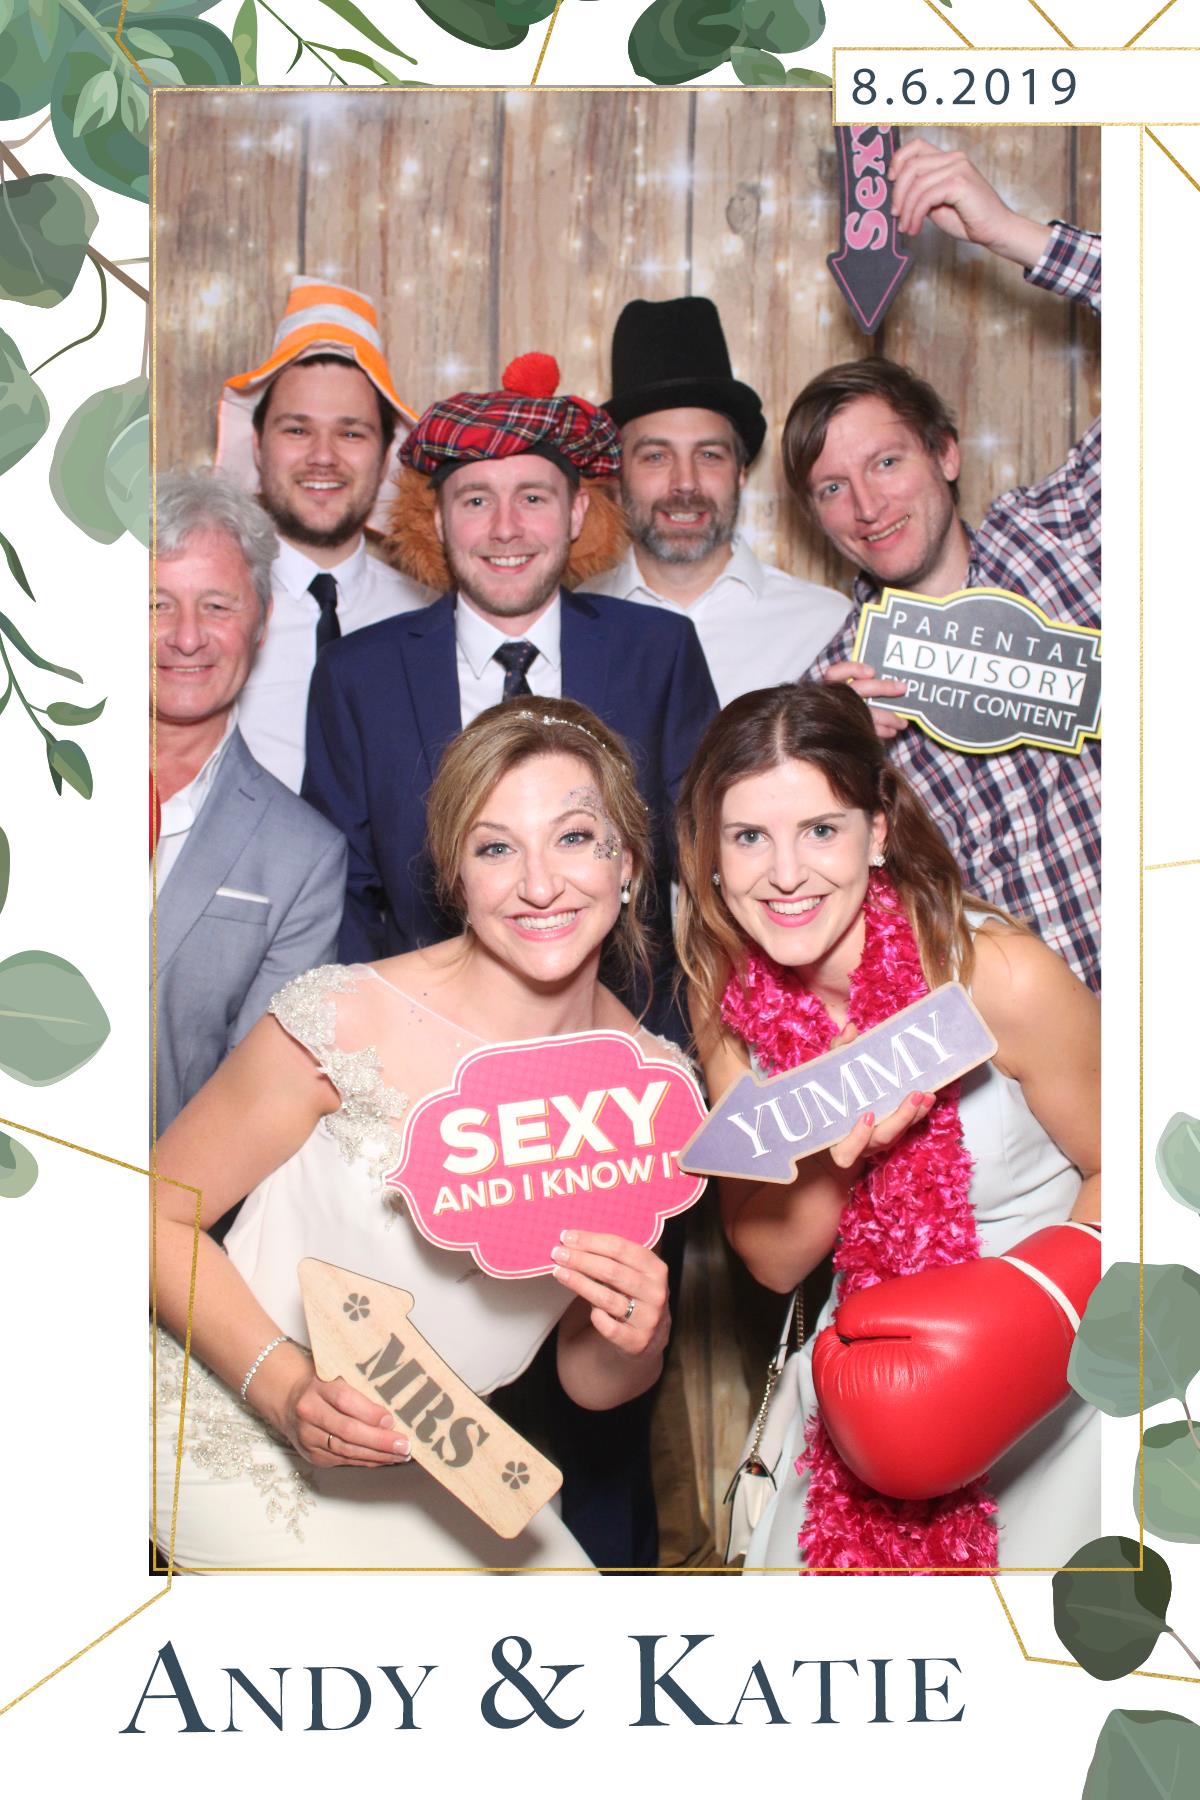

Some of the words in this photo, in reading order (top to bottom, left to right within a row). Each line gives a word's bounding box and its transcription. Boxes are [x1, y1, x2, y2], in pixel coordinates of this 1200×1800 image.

[886, 640, 1086, 700] ADVISORY
[892, 610, 1088, 668] PARENTAL
[973, 697, 1077, 731] CONTENT
[727, 1010, 955, 1160] YUMMY
[439, 1080, 672, 1175] SEXY
[432, 1177, 516, 1216] AND
[522, 1173, 534, 1201] I
[541, 1154, 656, 1198] KNOW
[355, 1332, 490, 1468] MRS
